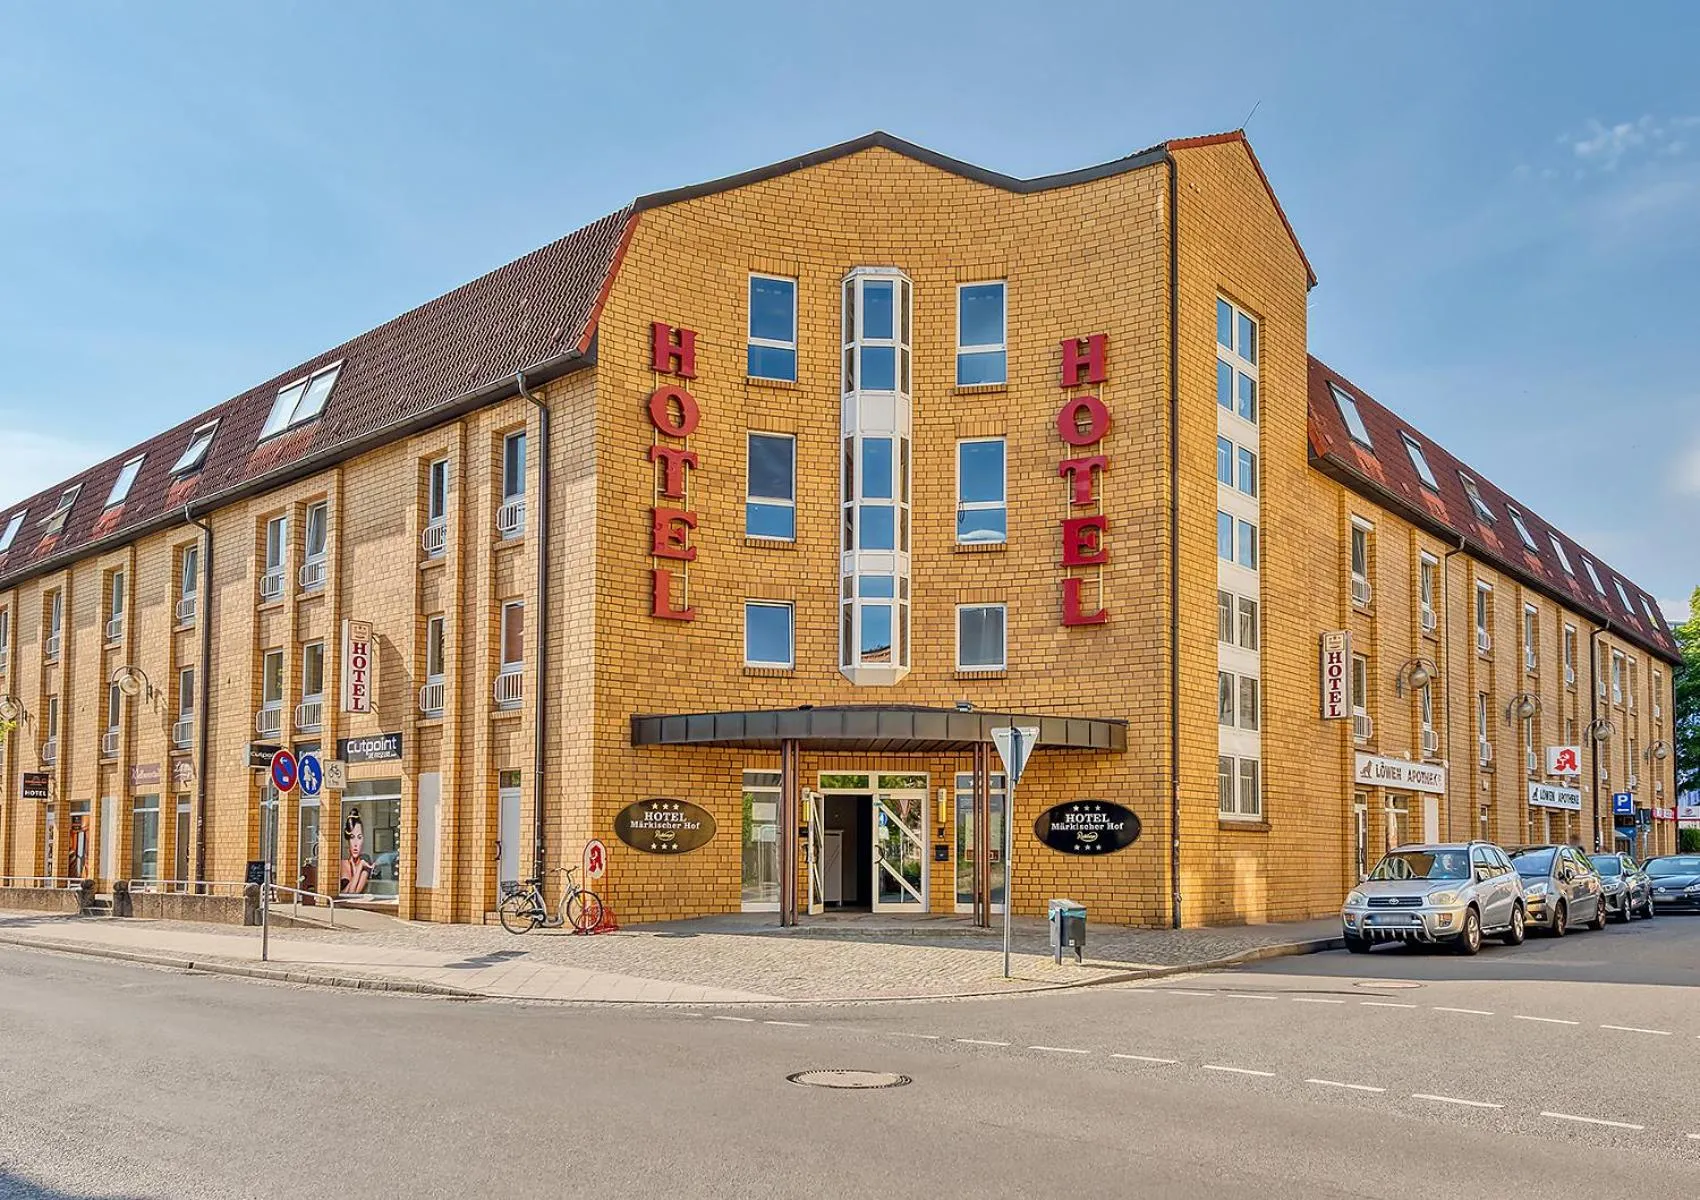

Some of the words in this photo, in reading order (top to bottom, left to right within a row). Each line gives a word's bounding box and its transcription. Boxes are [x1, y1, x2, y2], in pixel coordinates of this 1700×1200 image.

[650, 321, 700, 621] HOTEL
[1057, 333, 1110, 627] HOTEL
[352, 642, 367, 710] HOTEL
[1328, 651, 1342, 717] HOTEL
[347, 737, 397, 756] Cutpoint
[1617, 794, 1629, 806] P
[644, 811, 687, 822] HOTEL
[1065, 813, 1110, 823] HOTEL
[630, 820, 681, 830] Märkischer
[684, 821, 700, 830] Hof
[1051, 821, 1105, 831] Märkischer
[1107, 822, 1124, 831] Hof
